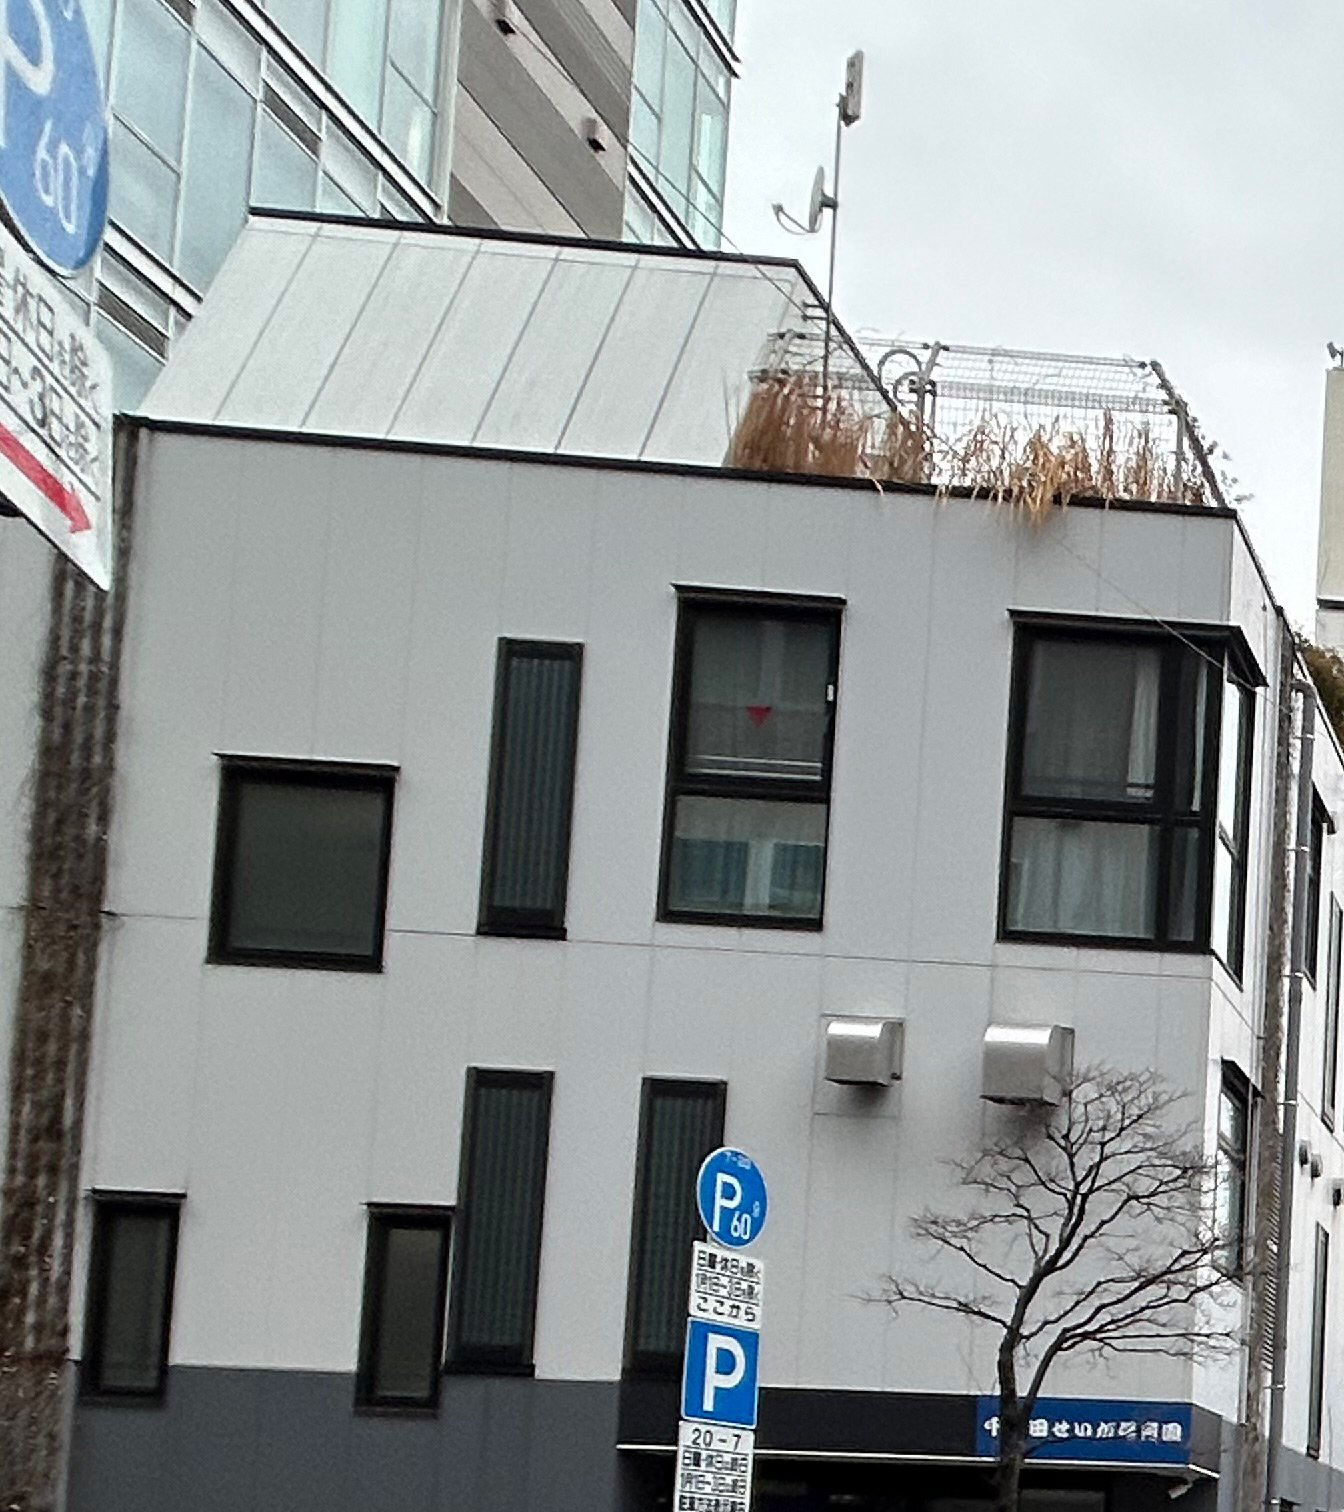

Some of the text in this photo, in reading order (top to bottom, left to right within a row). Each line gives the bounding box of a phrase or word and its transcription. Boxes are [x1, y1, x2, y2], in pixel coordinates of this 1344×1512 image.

[712, 1172, 752, 1240] P 60
[696, 1295, 756, 1323] ここから
[703, 1332, 746, 1412] P
